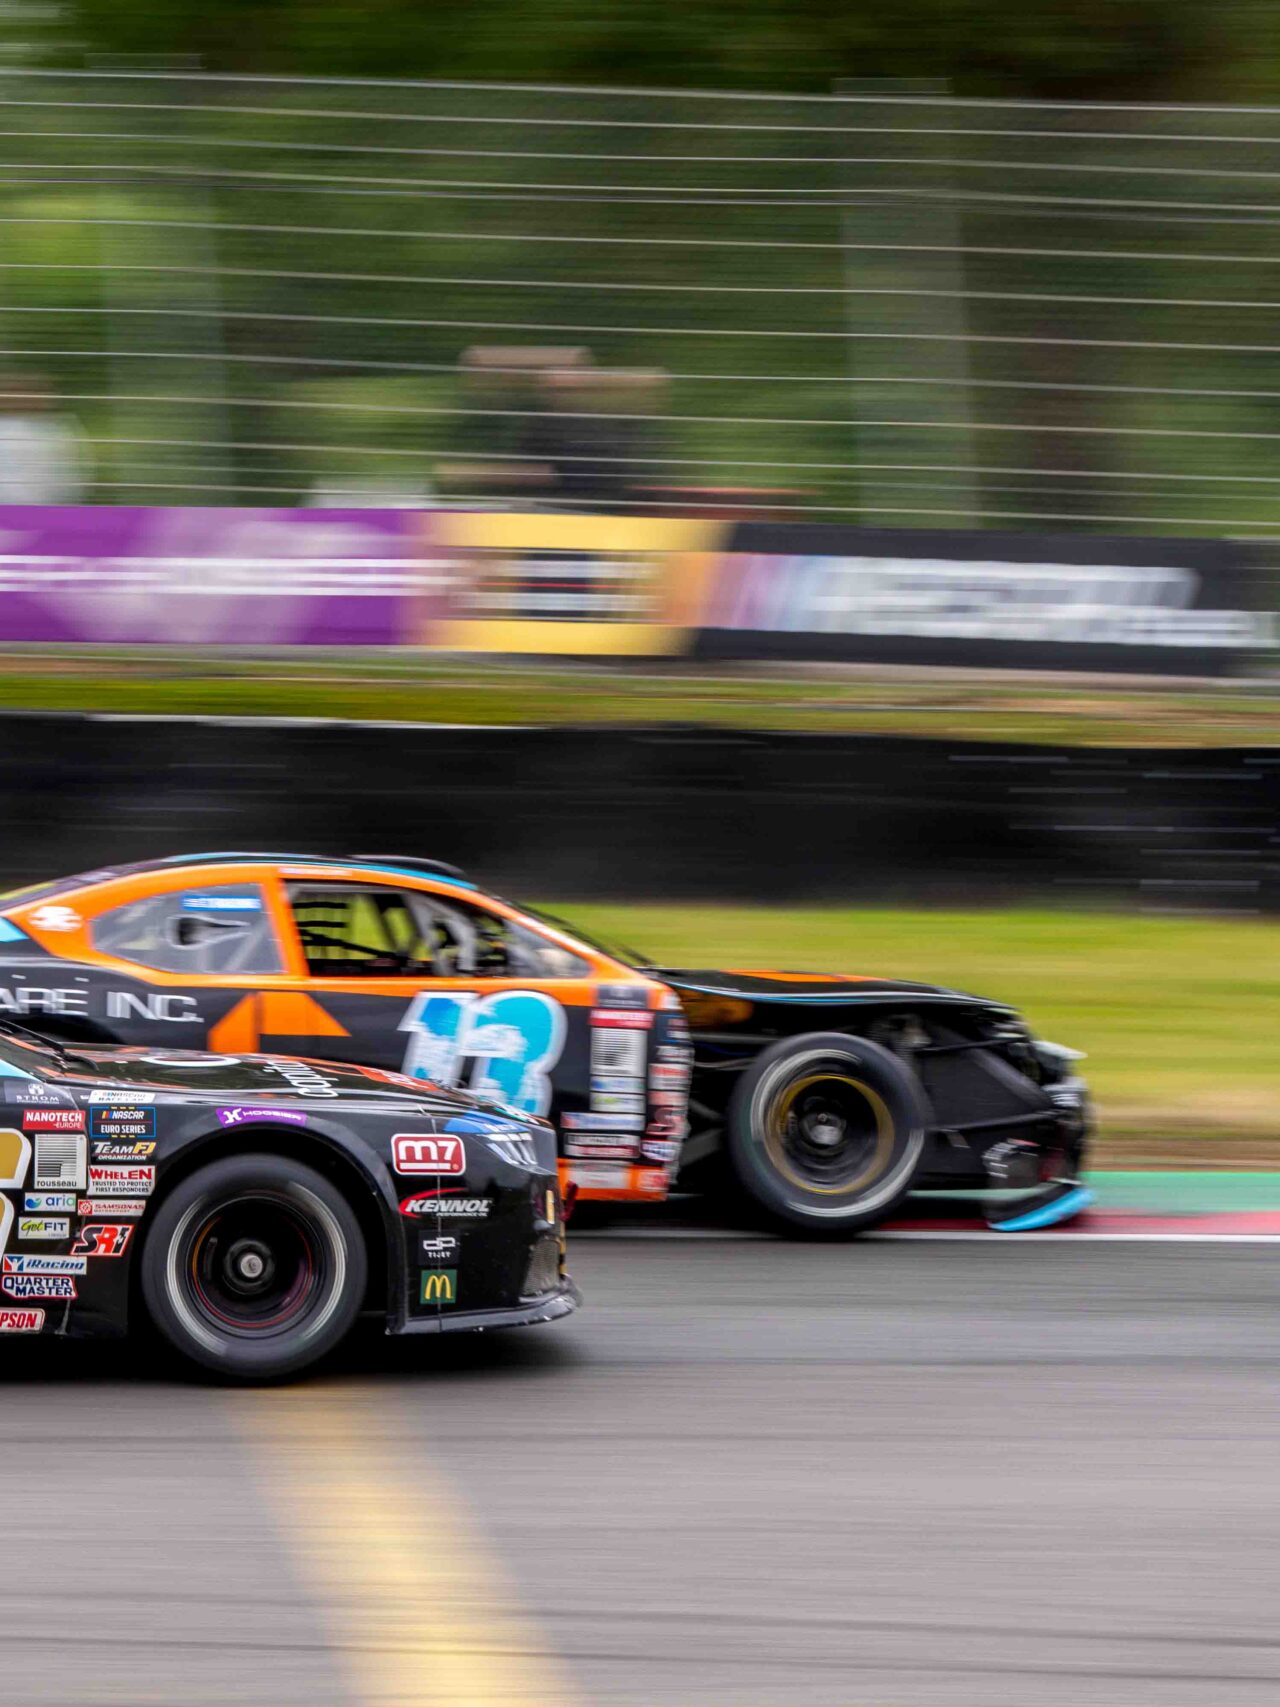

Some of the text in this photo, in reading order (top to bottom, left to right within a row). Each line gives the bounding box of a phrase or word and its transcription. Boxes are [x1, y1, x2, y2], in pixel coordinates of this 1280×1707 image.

[26, 1112, 83, 1122] NANOTECH
[112, 1110, 145, 1120] NASCAR
[100, 1124, 146, 1134] EURO SERIES
[89, 1167, 152, 1180] WHELEN
[36, 1180, 78, 1188] rousseau
[405, 1199, 491, 1212] KENNOL
[25, 1258, 85, 1270] iRacing
[4, 1276, 71, 1290] QUARTER
[14, 1285, 74, 1297] MASTER
